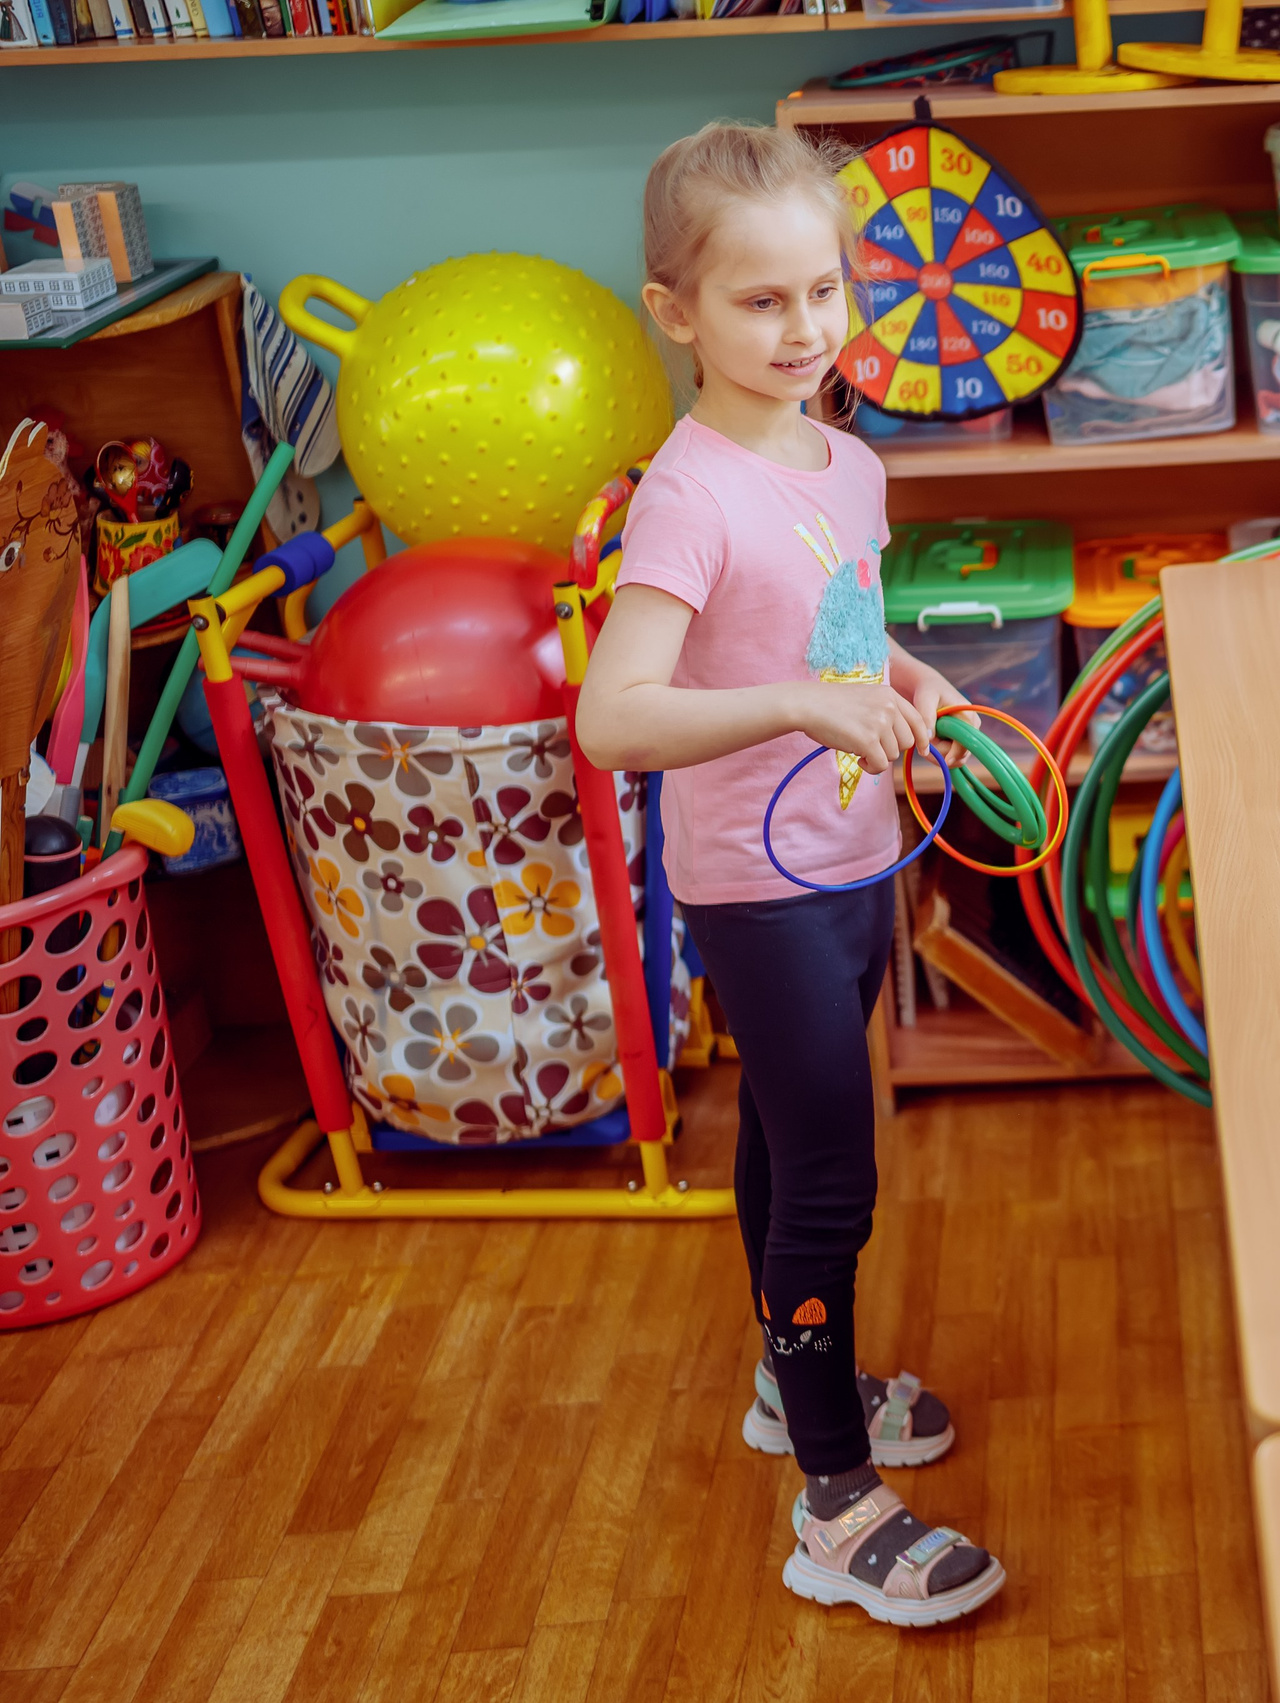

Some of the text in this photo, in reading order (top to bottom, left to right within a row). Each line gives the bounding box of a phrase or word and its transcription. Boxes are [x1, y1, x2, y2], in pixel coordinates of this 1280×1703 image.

[887, 145, 915, 172] 10
[941, 147, 973, 176] 30
[933, 206, 962, 224] 150
[994, 193, 1023, 218] 10
[874, 224, 904, 240] 140
[964, 227, 995, 245] 100
[979, 262, 1009, 279] 160
[1026, 252, 1063, 276] 40
[869, 286, 897, 303] 190
[982, 291, 1011, 308] 110
[971, 320, 1000, 336] 170
[1036, 308, 1068, 331] 10
[910, 336, 938, 352] 180
[942, 336, 972, 352] 120
[854, 356, 881, 383] 10
[1006, 353, 1043, 377] 50
[898, 377, 928, 401] 60
[955, 377, 983, 399] 10
